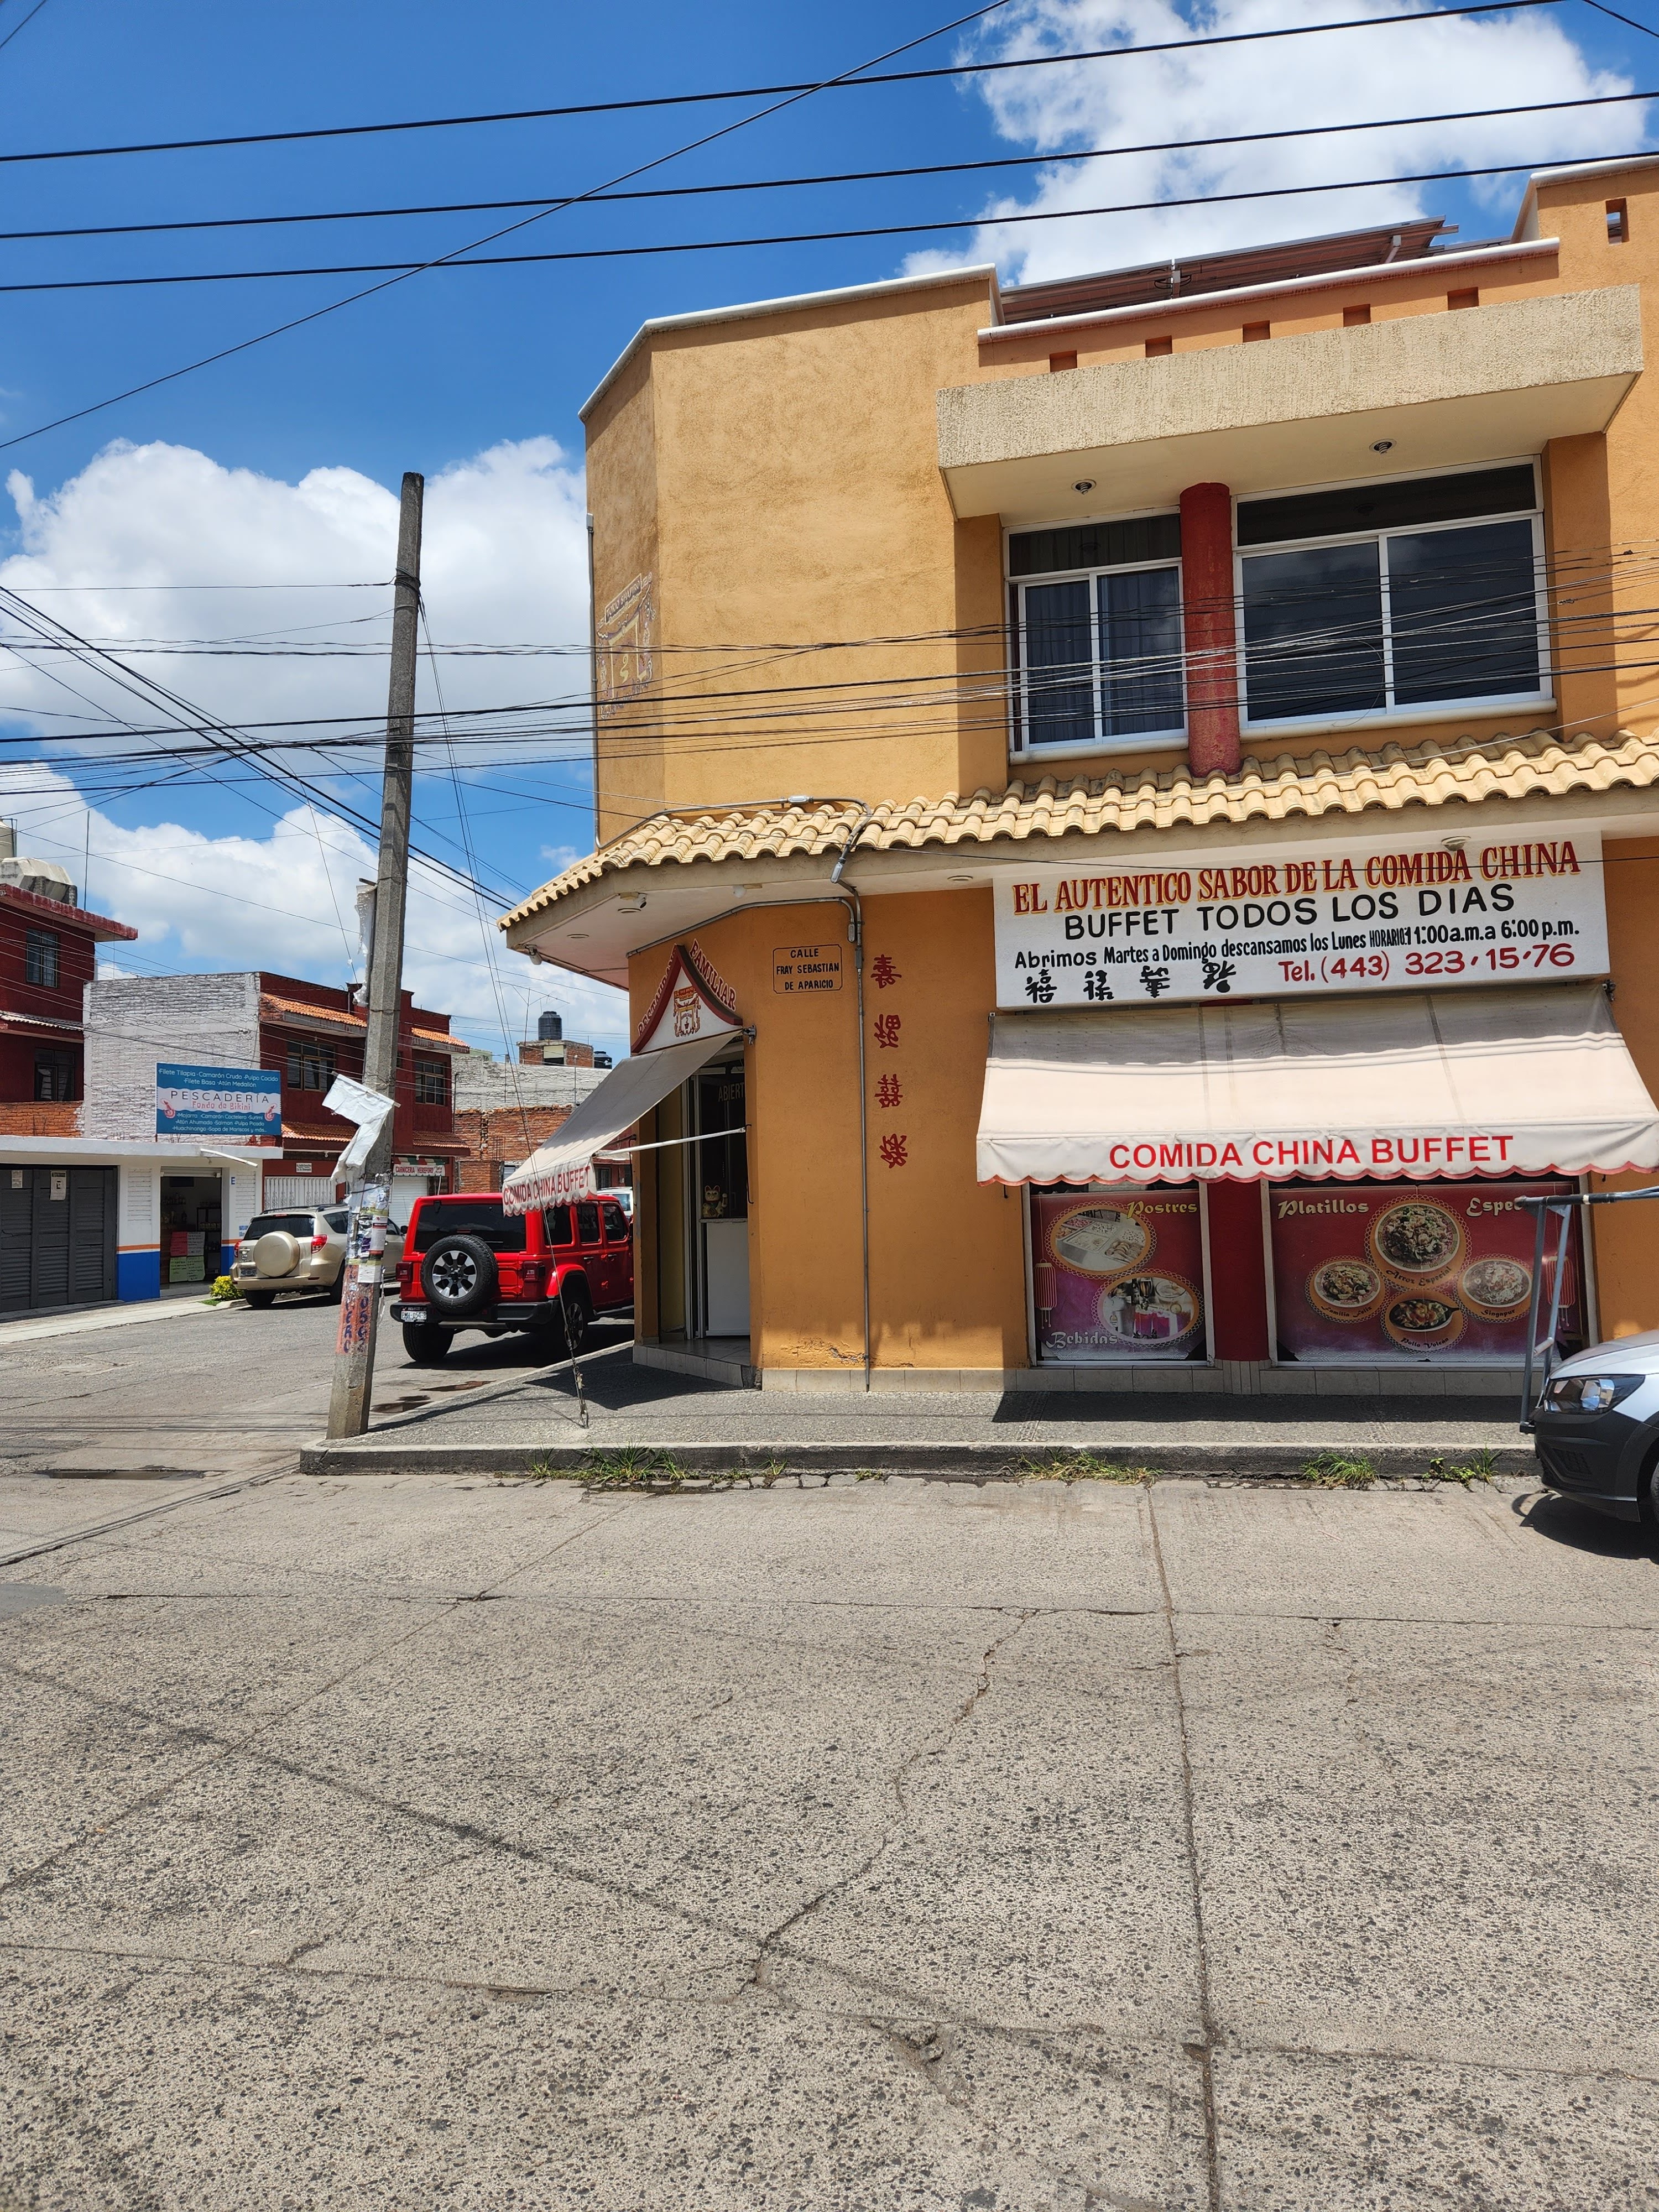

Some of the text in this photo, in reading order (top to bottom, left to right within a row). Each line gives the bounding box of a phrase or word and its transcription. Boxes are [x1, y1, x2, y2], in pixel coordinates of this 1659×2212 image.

[1013, 841, 1581, 915] EL AUTENTICO SABOR DE LA COMIDA CHINA
[1065, 883, 1514, 940] BUFFET TODOS LOS DIAS
[790, 948, 818, 958] CALLE
[1015, 950, 1097, 968] Abrimos
[1104, 946, 1148, 964] Martes
[1152, 948, 1160, 961] a
[1162, 942, 1217, 964] Domingo
[1221, 938, 1307, 958] descansamos
[1310, 933, 1328, 952] los
[1332, 931, 1366, 951] Lunes
[690, 938, 737, 1012] FAMILIAR
[776, 962, 839, 975] FRAY SEBASTIAN
[1278, 960, 1315, 982] Tel.
[1321, 951, 1390, 983] (443)
[785, 979, 833, 990] DE APARICIO
[171, 1091, 269, 1103] PESCADERÍA
[1109, 1136, 1514, 1168] COMIDA CHINA BUFFET
[504, 1166, 590, 1206] COMIDA CHINA BUFFET
[1126, 1201, 1197, 1219] Postres
[1278, 1199, 1369, 1219] Platillos
[1386, 1266, 1452, 1286] Arroz Especial
[1321, 1306, 1372, 1318] Familia Feliz
[1480, 1309, 1515, 1318] Singapur
[1046, 1331, 1119, 1349] Bebidas
[1401, 1337, 1421, 1348] Pollo
